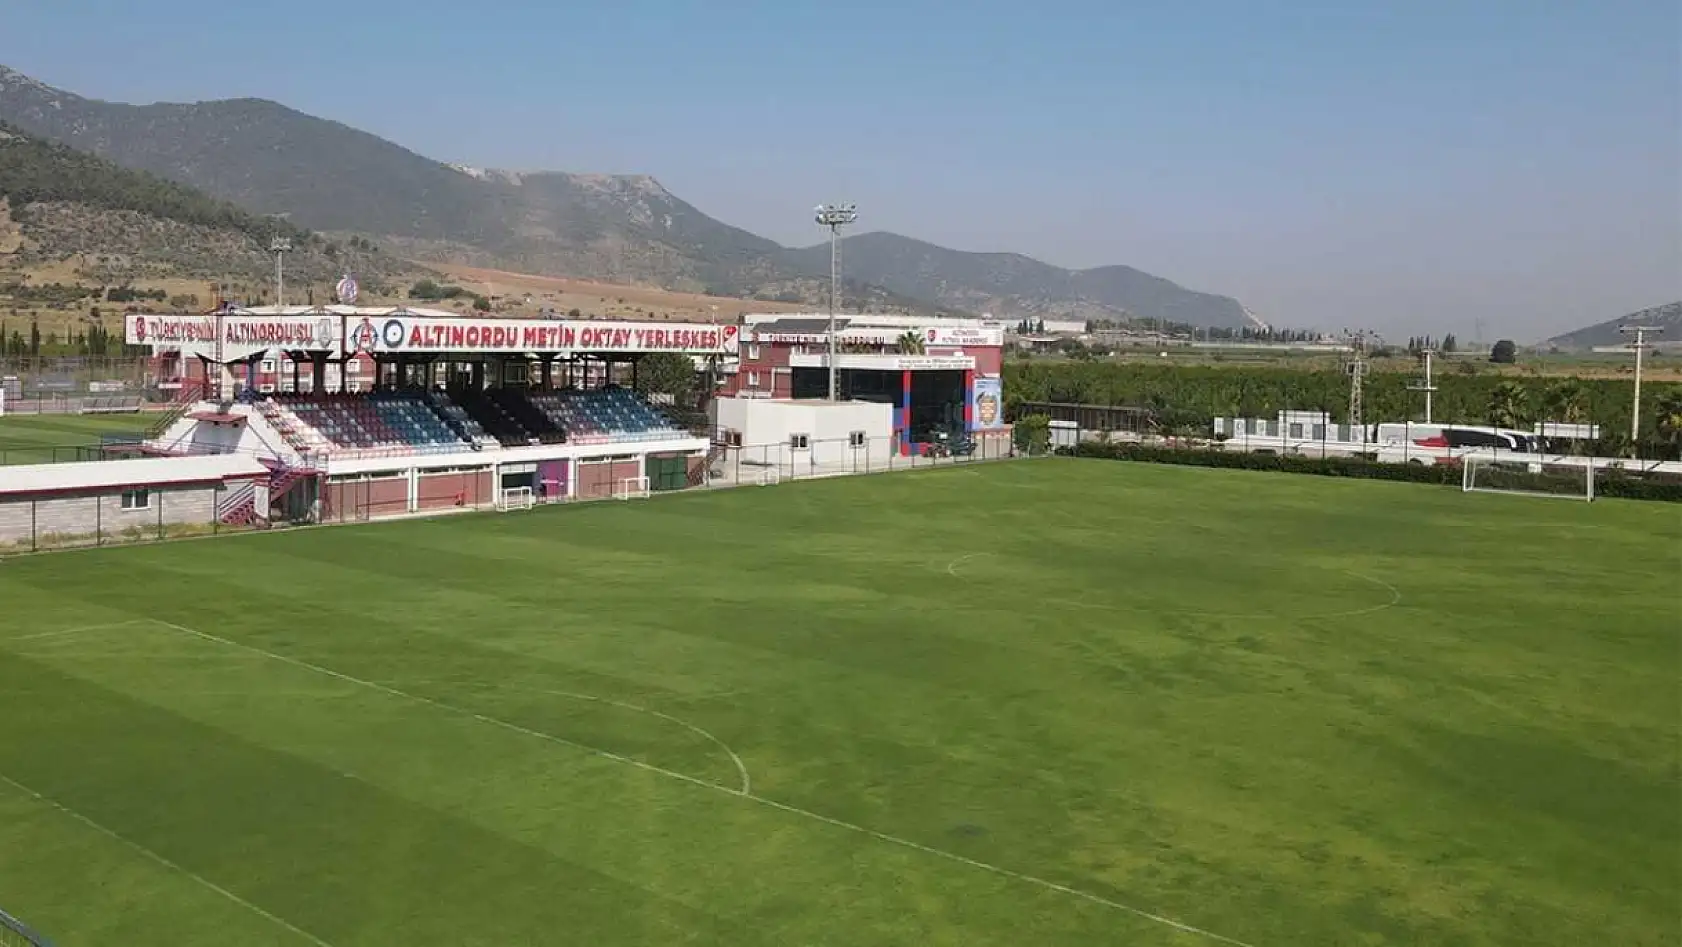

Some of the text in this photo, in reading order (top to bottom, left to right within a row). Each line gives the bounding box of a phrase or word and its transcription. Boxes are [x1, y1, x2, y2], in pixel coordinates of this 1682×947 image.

[226, 322, 313, 344] ALTINORDU'SU
[408, 325, 721, 350] ALTINORDU METİN OKTAY YERLEŞKESİ
